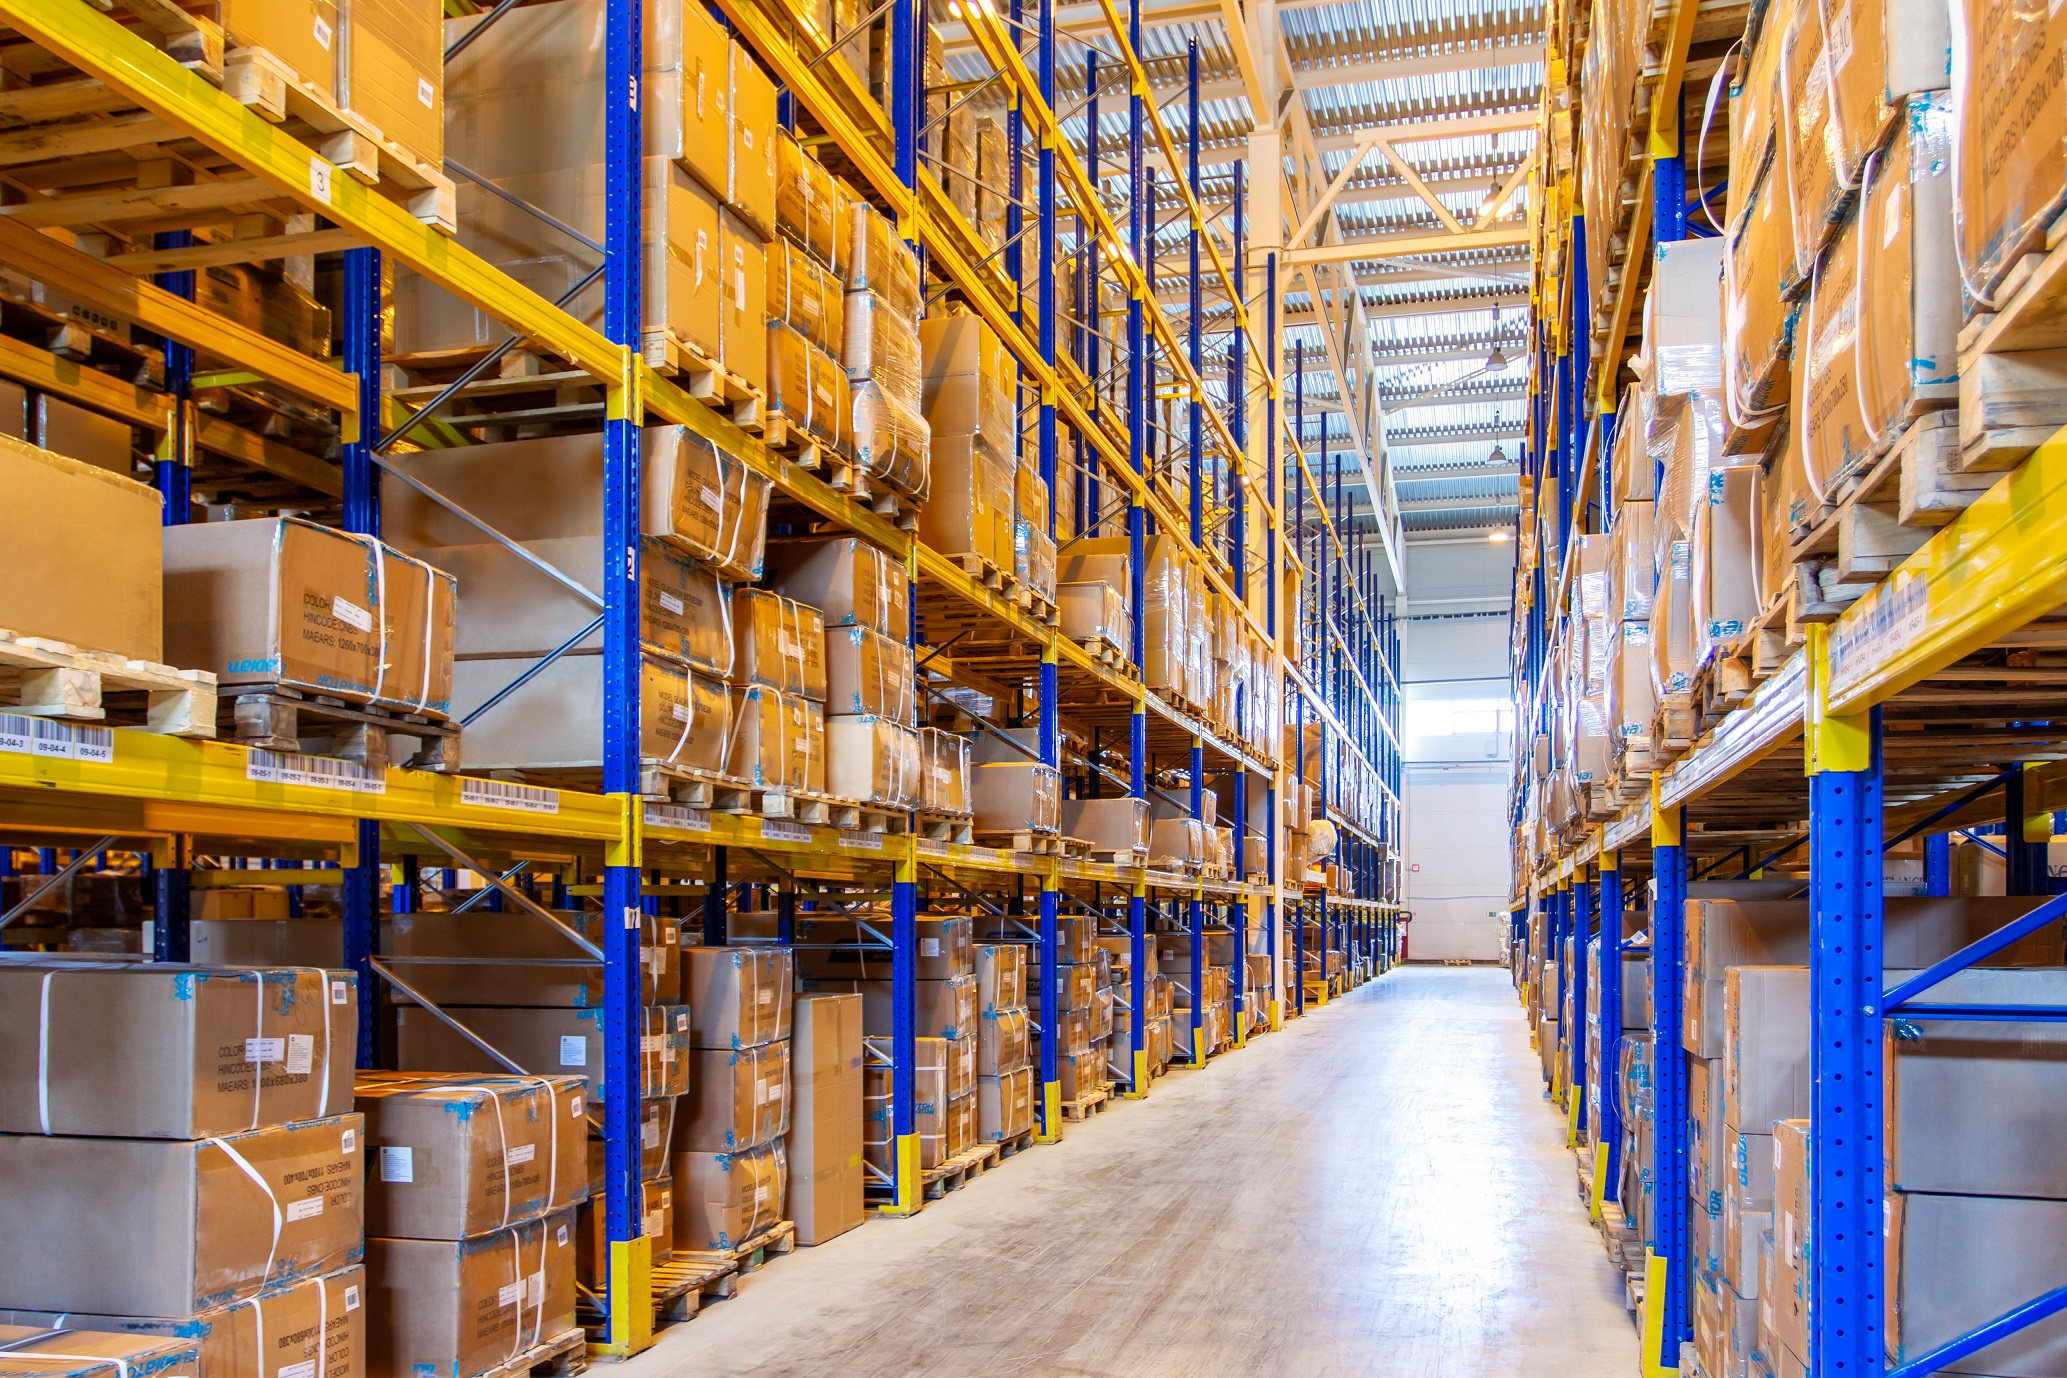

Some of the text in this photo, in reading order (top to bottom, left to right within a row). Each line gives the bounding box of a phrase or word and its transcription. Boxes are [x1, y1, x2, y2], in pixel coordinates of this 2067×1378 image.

[317, 172, 325, 192] 3
[39, 743, 66, 753] 09-04-4
[80, 748, 106, 758] 09-04-5
[251, 768, 271, 778] 09-05-1
[281, 773, 301, 781] 09-05-2
[310, 776, 329, 784] 09-05-3
[338, 779, 356, 787] 09-05-4
[283, 1166, 324, 1185] 1100x700x400
[306, 1177, 351, 1196] HINCODE:CNBS
